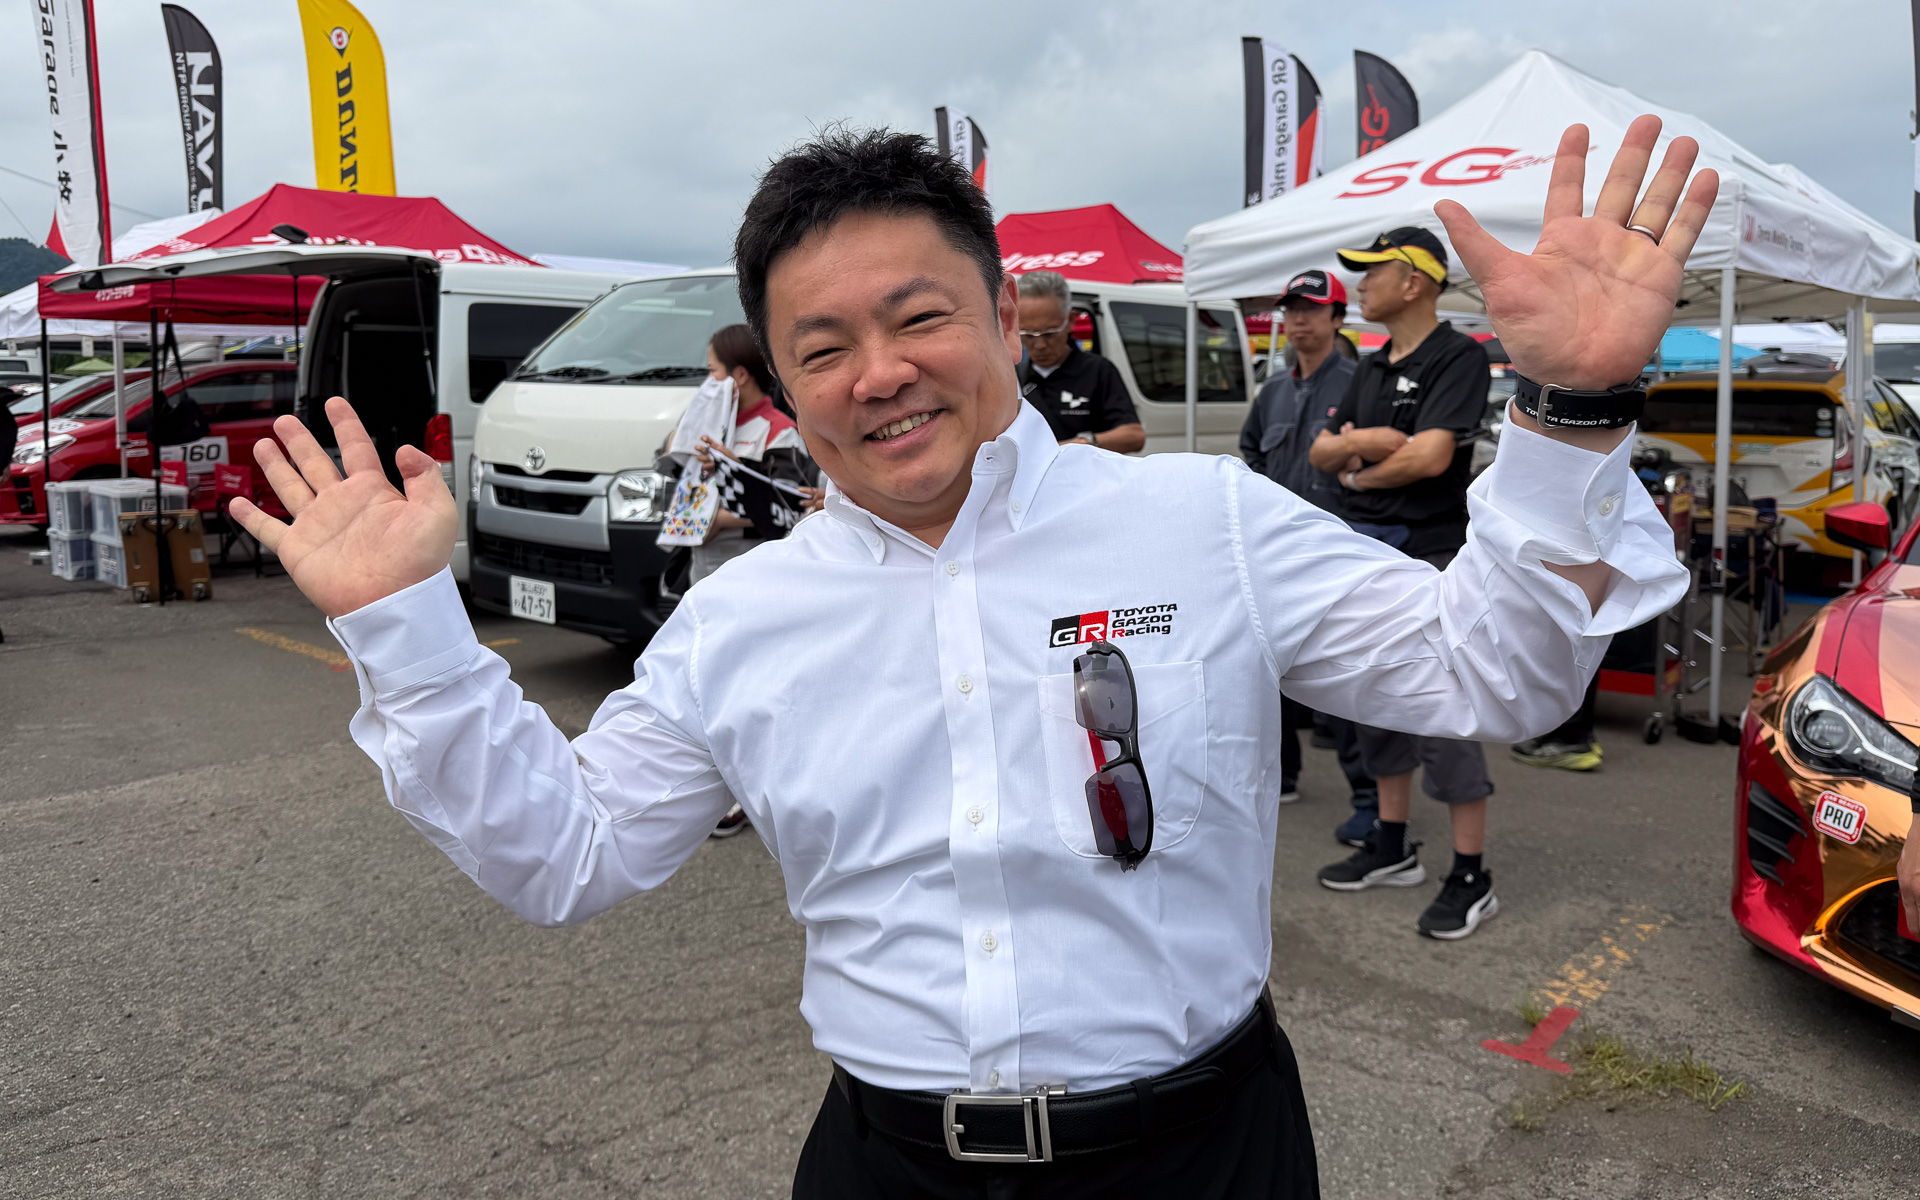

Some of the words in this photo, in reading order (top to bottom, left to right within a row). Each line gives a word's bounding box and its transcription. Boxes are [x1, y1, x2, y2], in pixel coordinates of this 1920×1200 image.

[175, 52, 187, 84] NTP
[179, 85, 192, 131] GROUP
[1335, 147, 1521, 199] SG
[1525, 406, 1558, 423] TOYTA
[1560, 418, 1597, 426] GAZOO
[180, 444, 221, 462] 160
[1112, 603, 1178, 619] TOYOTA
[1112, 614, 1173, 629] GAZOO
[1052, 623, 1106, 646] GR
[1112, 624, 1171, 639] Racing
[1823, 804, 1854, 830] PRO
